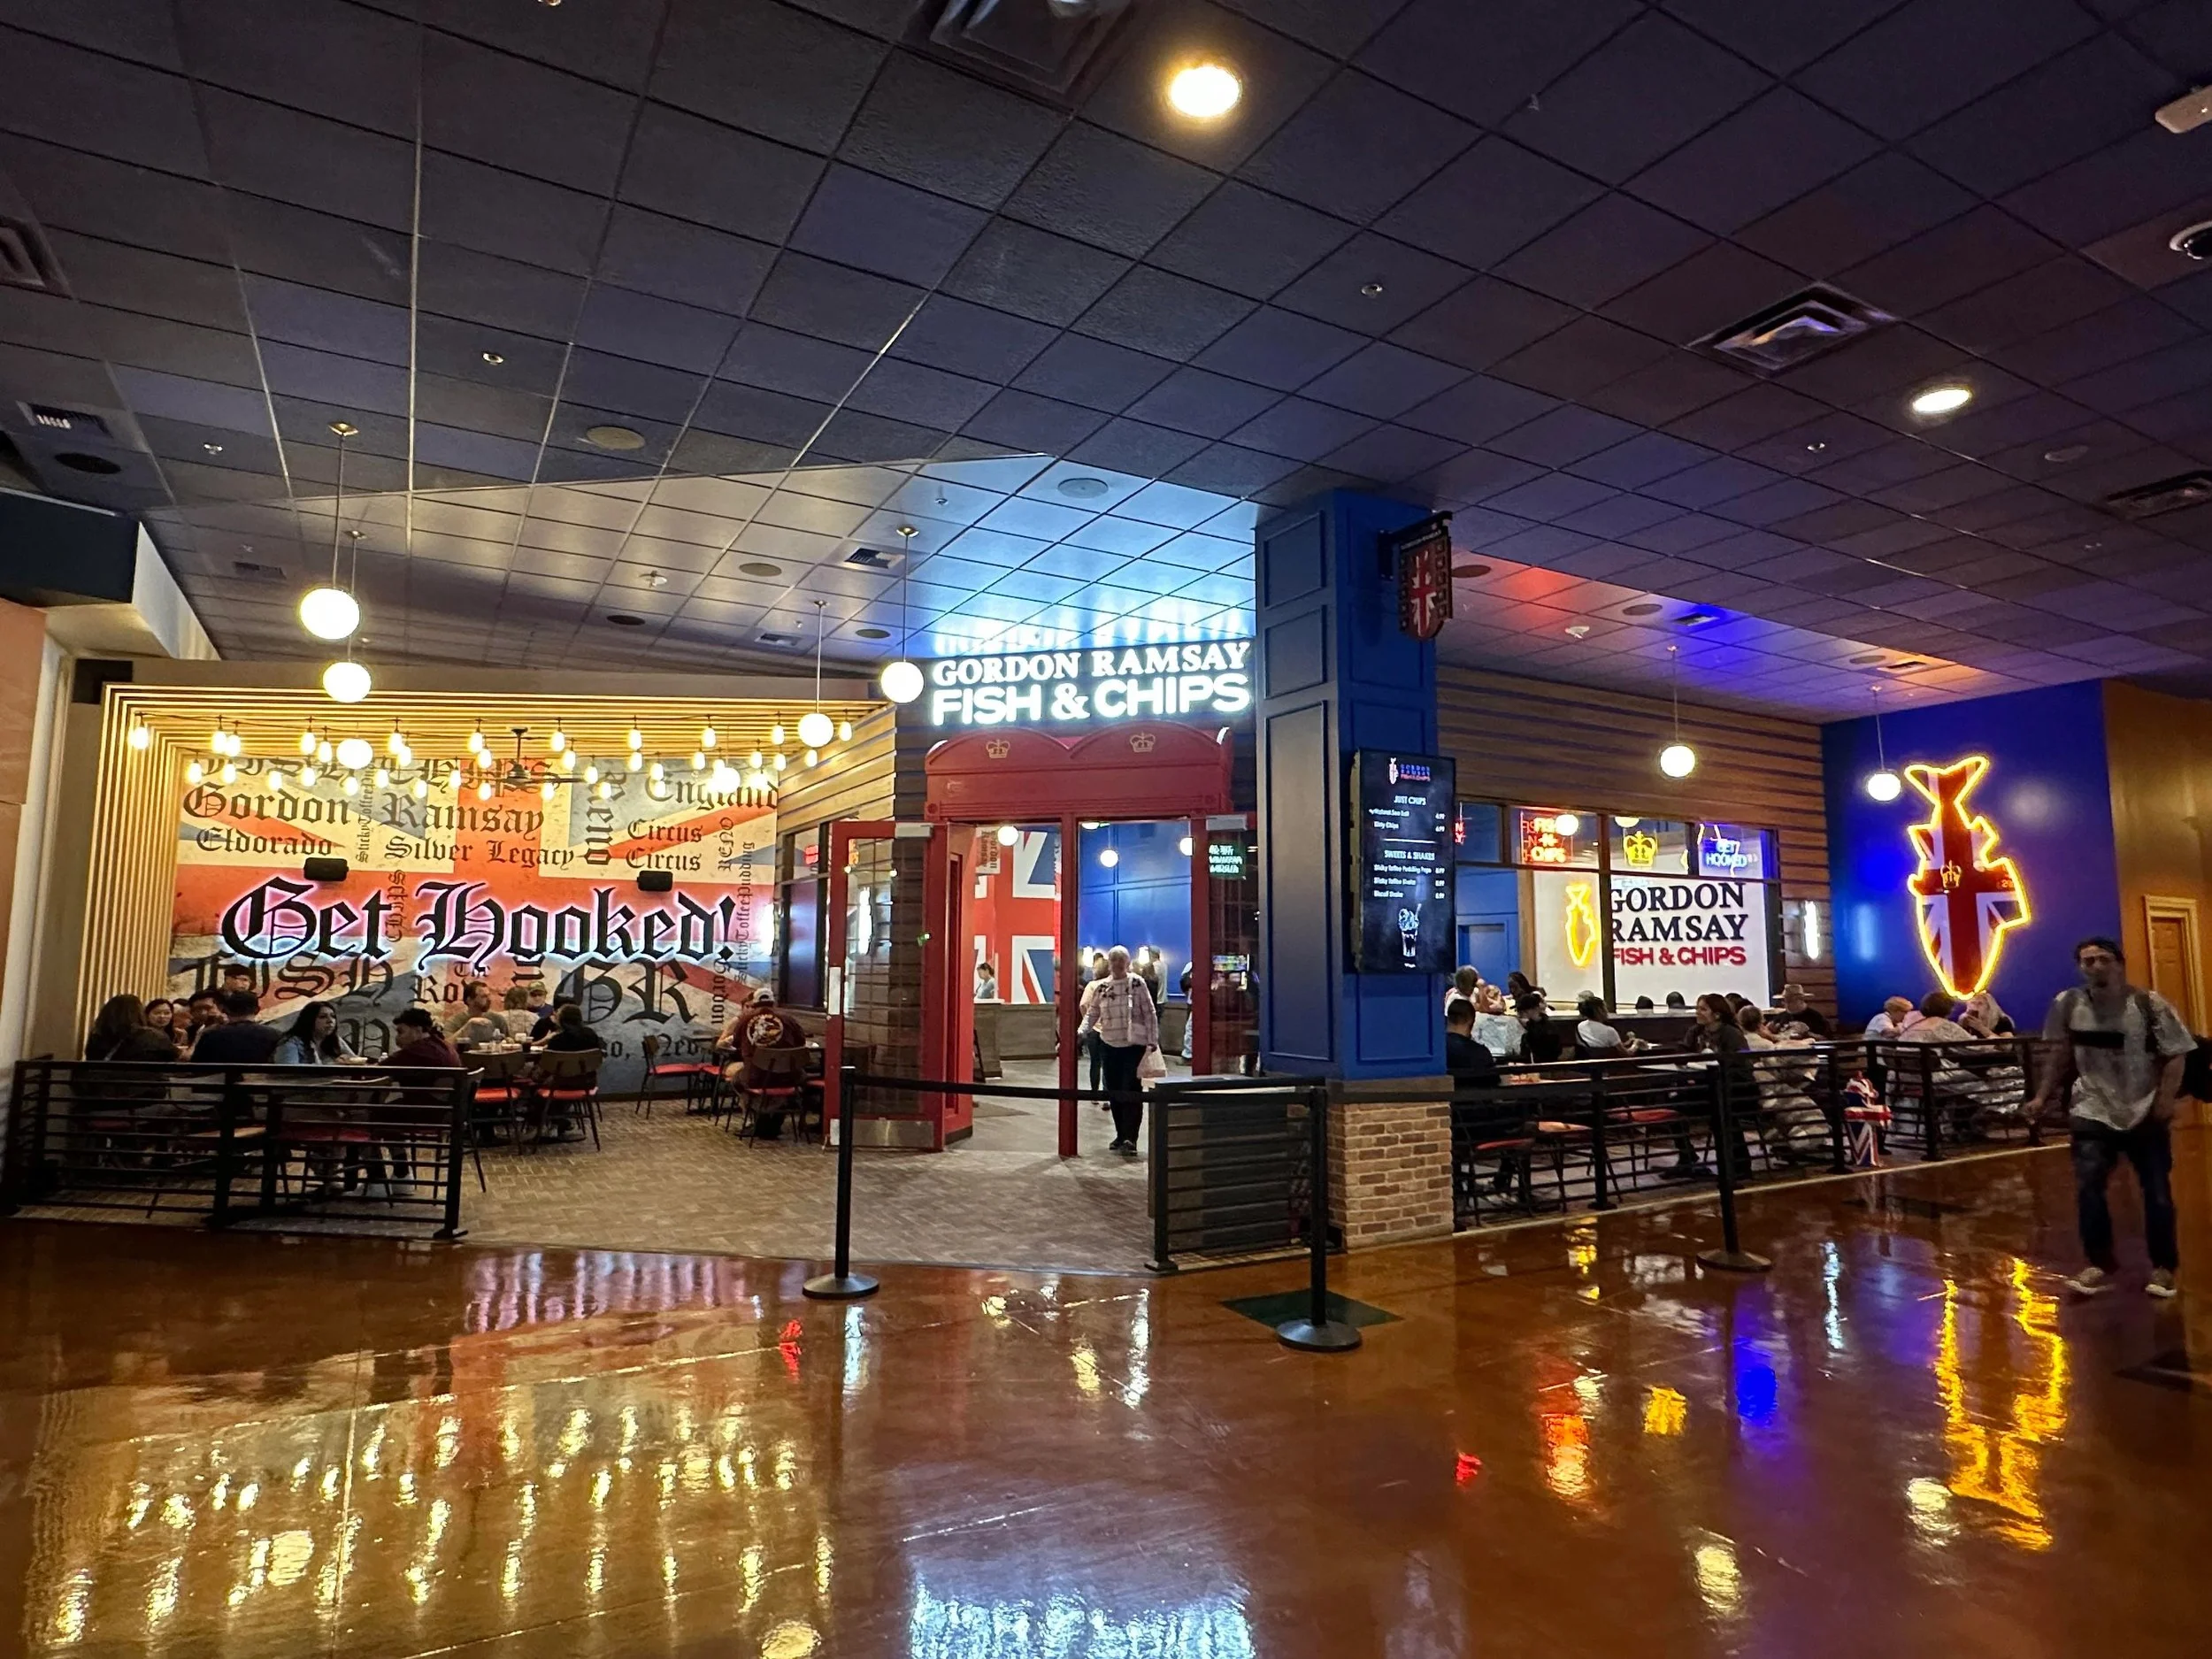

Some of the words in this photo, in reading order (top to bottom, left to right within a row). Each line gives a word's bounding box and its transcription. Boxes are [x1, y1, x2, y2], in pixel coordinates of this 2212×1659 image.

[932, 652, 1081, 686] GORDON
[1092, 641, 1251, 678] RAMSAY
[933, 684, 1042, 726] FISH
[1049, 683, 1091, 720] &
[1094, 672, 1251, 718] CHIPS
[183, 781, 350, 825] Gordon
[380, 793, 543, 841] Ramsay
[196, 827, 332, 856] Eldorado
[627, 818, 703, 842] Circus
[385, 836, 472, 862] Silver
[488, 841, 574, 870] Legacy
[626, 848, 702, 871] Circus
[1706, 852, 1747, 867] HOOKED
[1610, 882, 1746, 913] GORDON
[221, 877, 393, 959] Get
[415, 881, 736, 972] Hooked!
[1612, 914, 1748, 943] RAMSAY
[1614, 947, 1654, 965] FISH
[1659, 948, 1675, 965] &
[1678, 947, 1747, 966] CHIPS
[407, 975, 469, 1003] Ro
